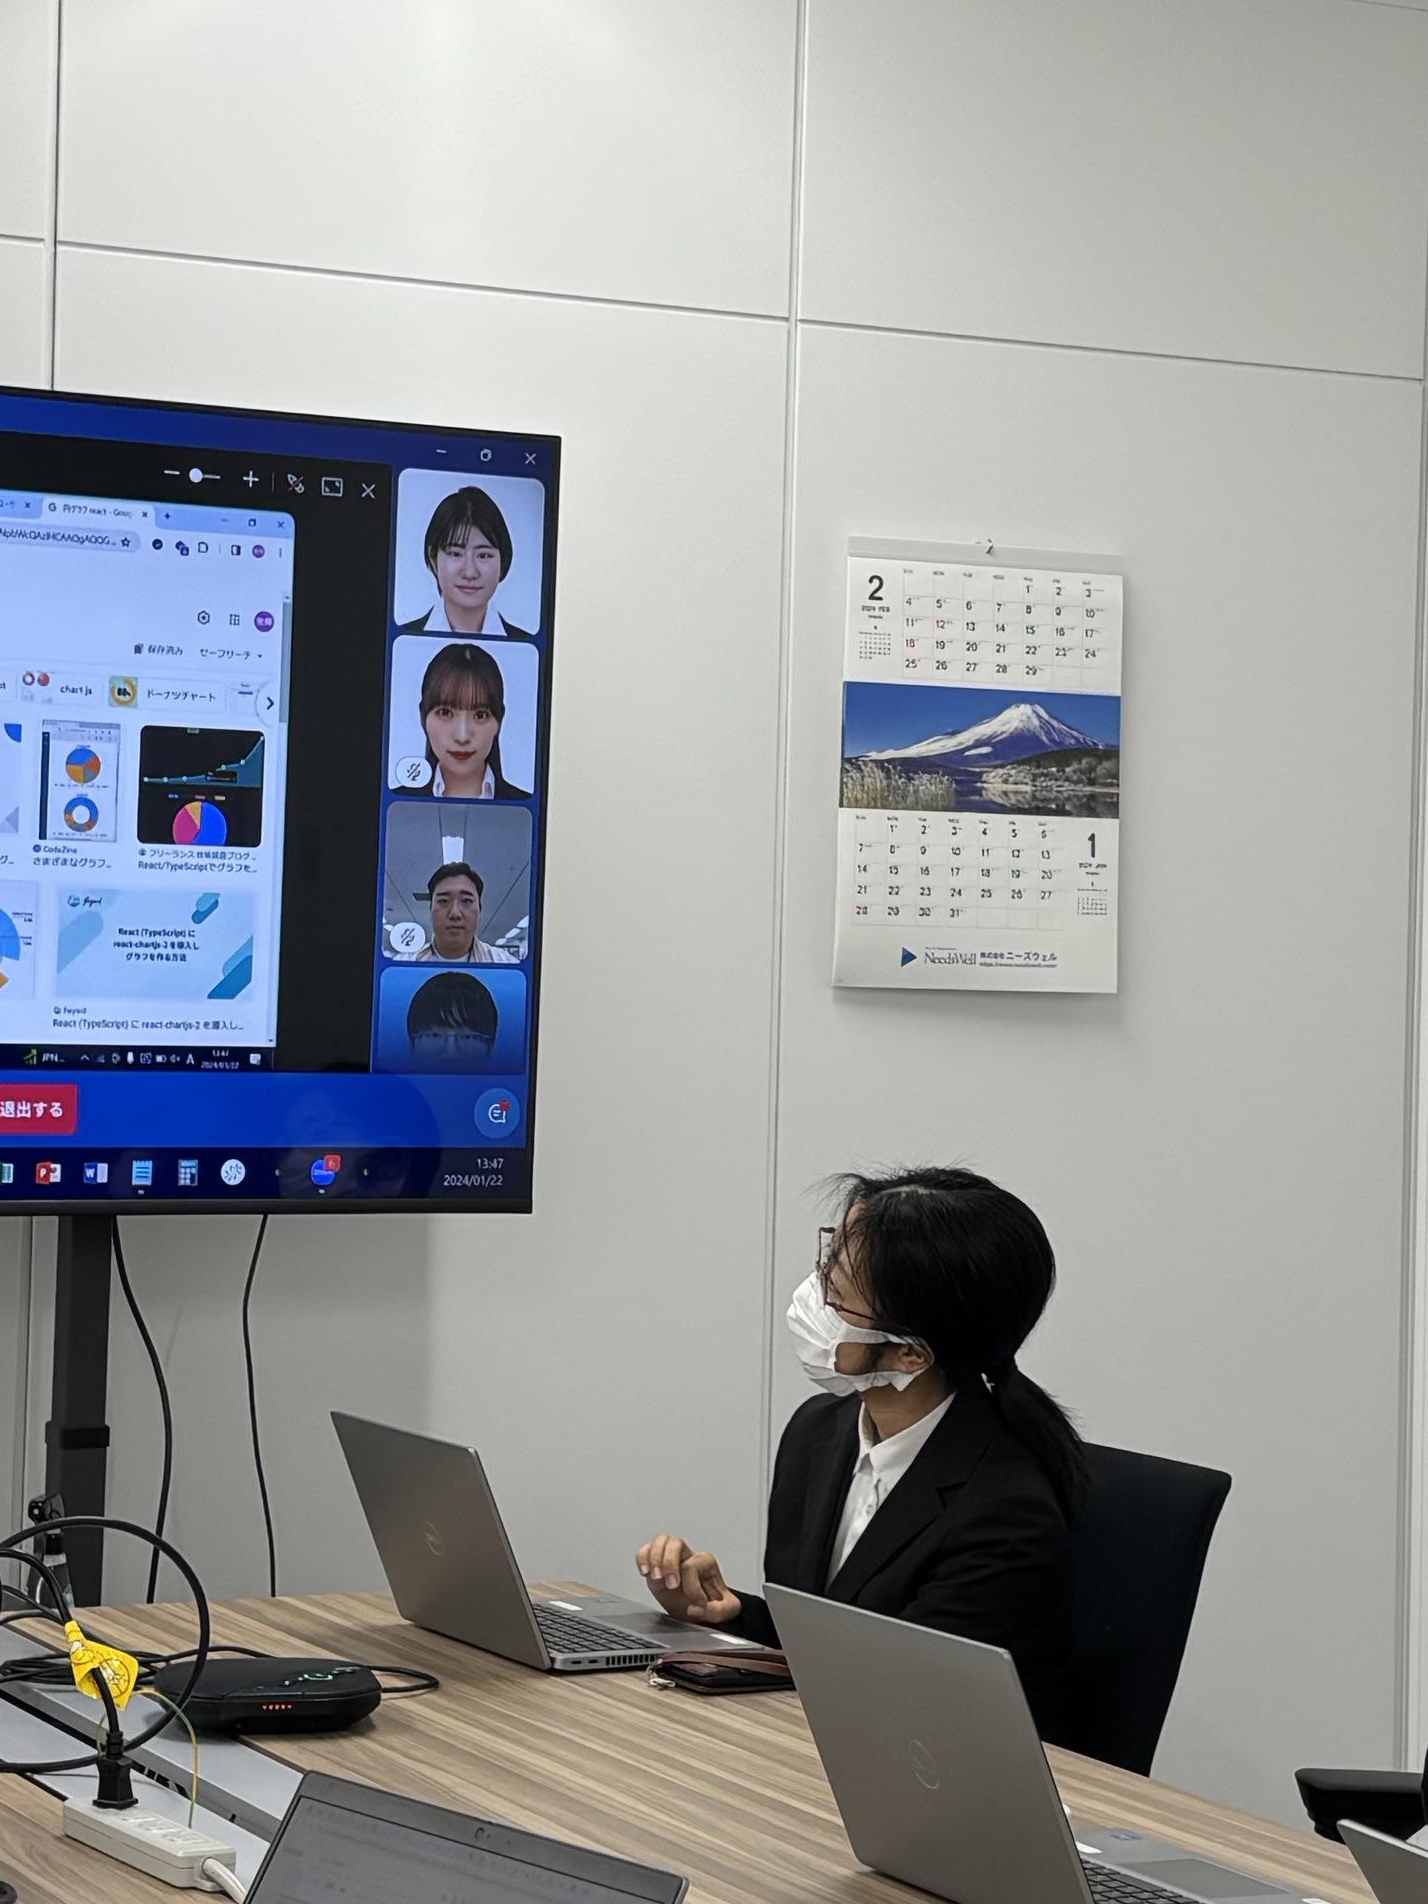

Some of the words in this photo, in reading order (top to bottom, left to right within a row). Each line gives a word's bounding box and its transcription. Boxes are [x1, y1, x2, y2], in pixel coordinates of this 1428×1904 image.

[868, 575, 884, 601] 2
[1026, 585, 1030, 594] 1
[1056, 587, 1062, 596] 2
[906, 598, 912, 606] 4
[936, 599, 943, 609] 5
[966, 601, 972, 610] 6
[996, 602, 1002, 612] 7
[1026, 605, 1032, 614] 8
[905, 618, 914, 627] 11
[936, 619, 945, 629] 12
[966, 622, 975, 631] 13
[996, 623, 1005, 632] 14
[1085, 629, 1094, 638] 17
[905, 639, 915, 648] 18
[936, 640, 946, 649] 19
[965, 642, 978, 652] 20
[996, 643, 1006, 653] 21
[1025, 645, 1037, 655] 22
[1085, 649, 1096, 658] 24
[905, 658, 917, 668] 25
[935, 660, 948, 670] 26
[965, 662, 977, 672] 27
[60, 685, 83, 695] chart
[890, 824, 894, 832] 1
[921, 825, 927, 835] 2
[1012, 828, 1018, 838] 5
[1041, 829, 1047, 839] 6
[858, 843, 864, 852] 7
[981, 848, 990, 857] 11
[1087, 832, 1096, 858] 1
[857, 864, 867, 873] 14
[920, 866, 930, 876] 16
[950, 867, 960, 876] 17
[857, 885, 867, 894] 21
[888, 885, 900, 895] 22
[919, 886, 931, 896] 23
[950, 887, 962, 897] 24
[981, 888, 992, 898] 25
[1041, 890, 1052, 900] 27
[949, 908, 959, 918] 31
[0, 1100, 63, 1118] 退出する
[476, 1158, 504, 1169] 13:47
[443, 1174, 504, 1188] 2024/01/22
